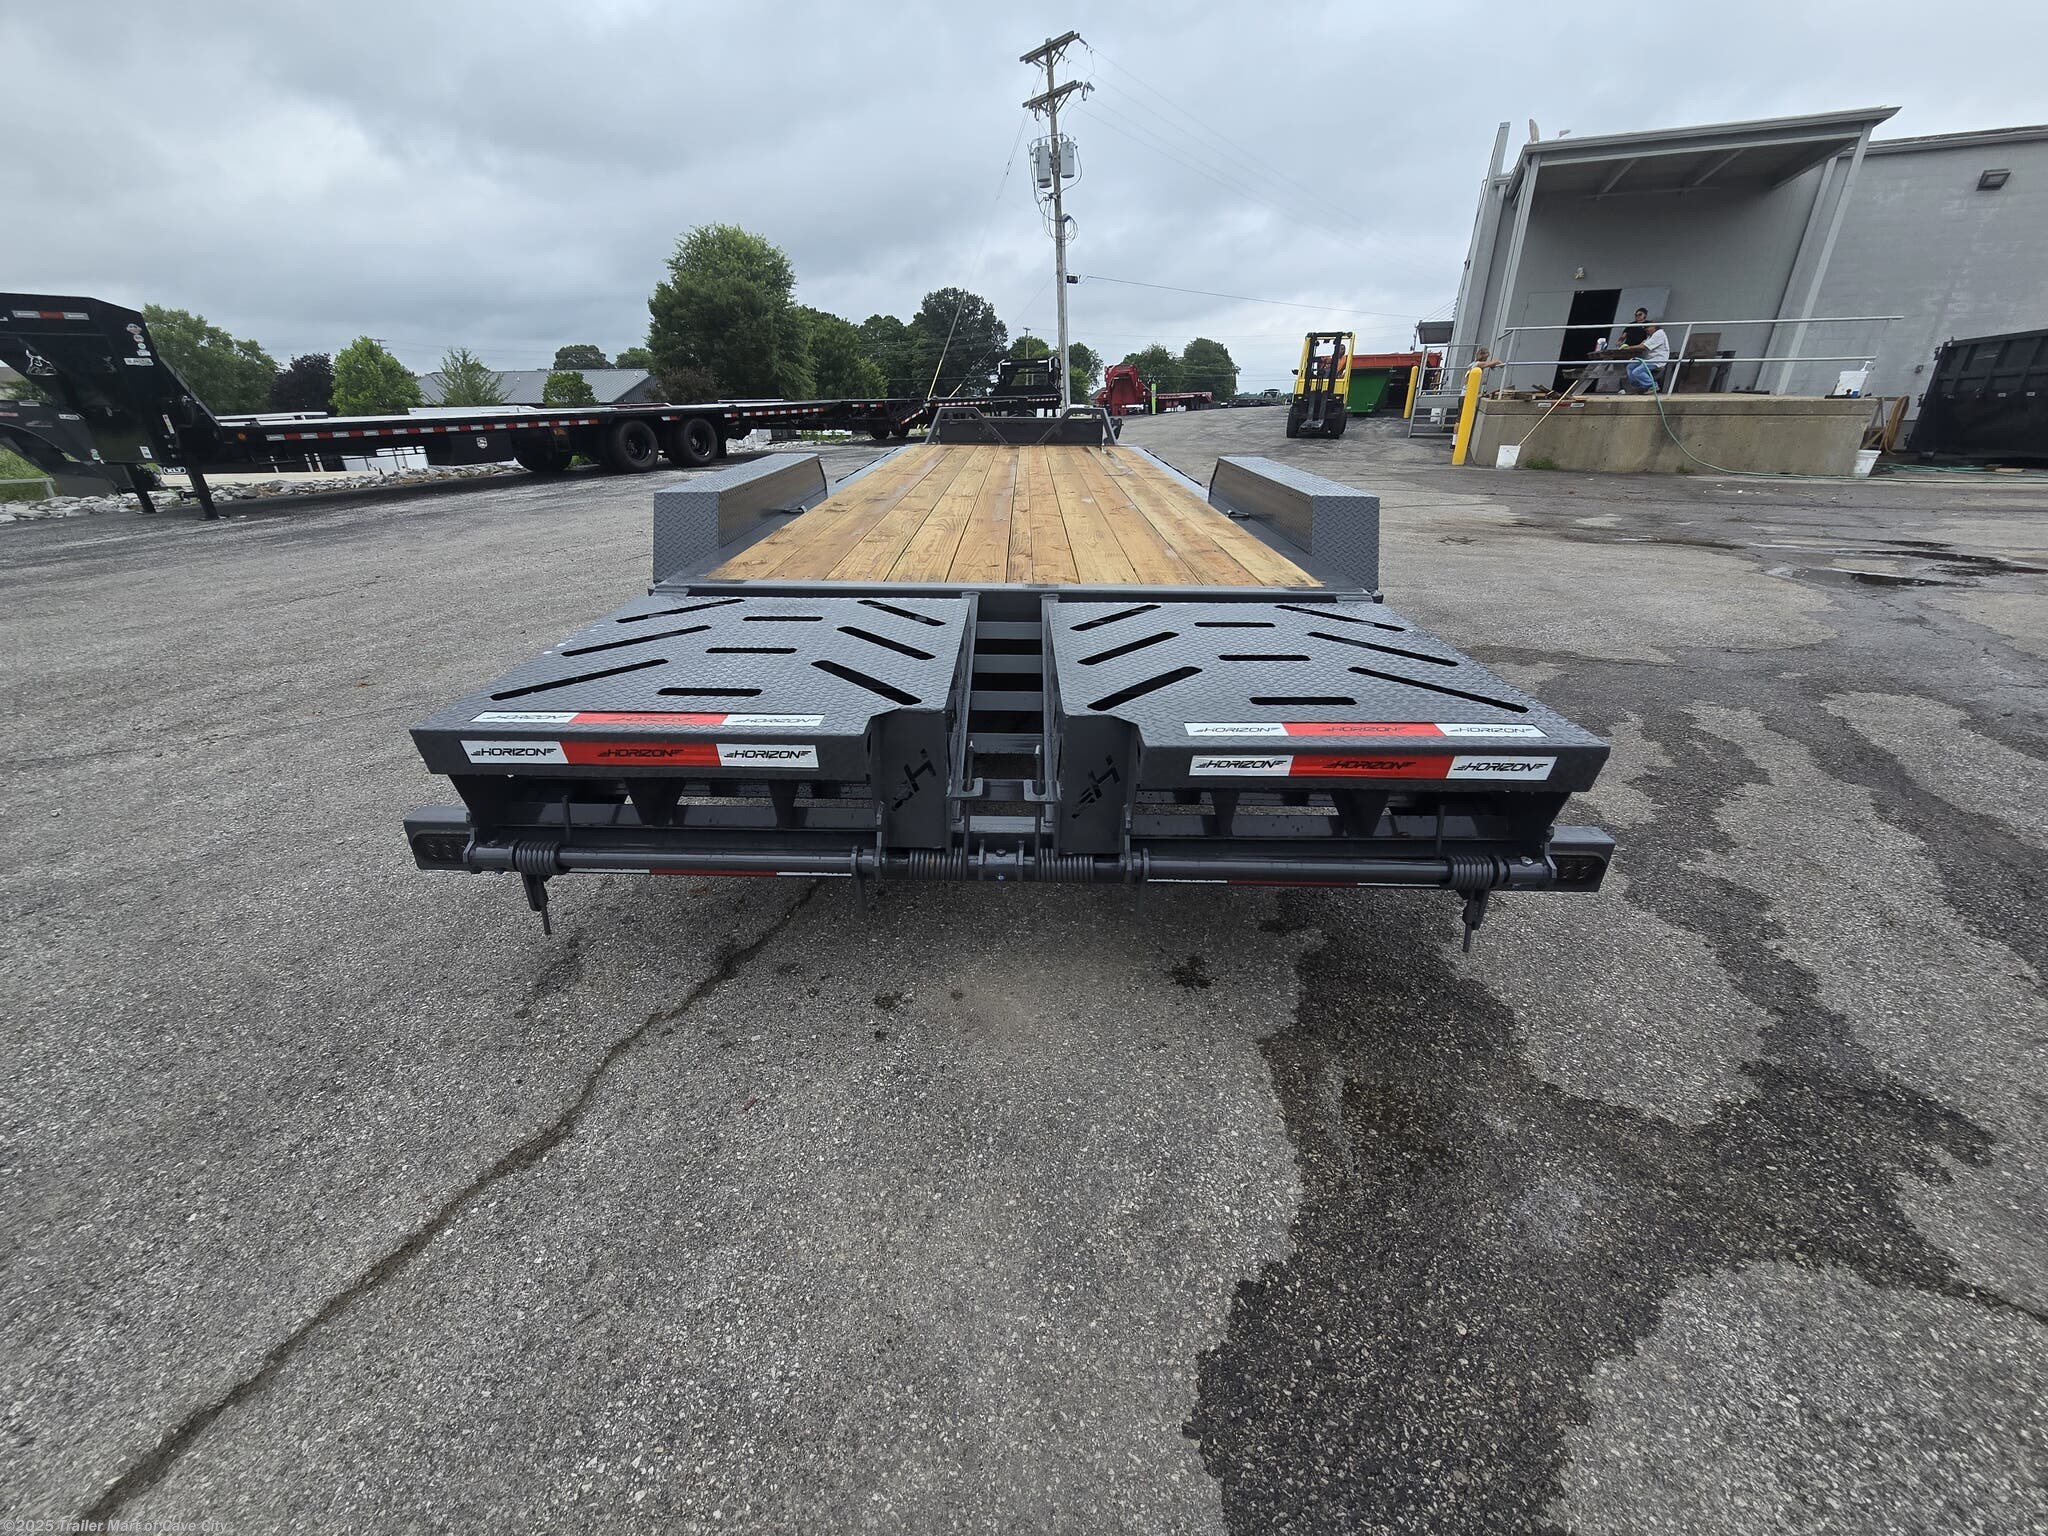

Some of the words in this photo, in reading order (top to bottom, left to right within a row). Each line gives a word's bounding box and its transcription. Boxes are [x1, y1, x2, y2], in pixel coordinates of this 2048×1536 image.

[481, 747, 547, 757] HORIZON
[607, 748, 674, 758] HORIZON
[734, 749, 801, 759] HORIZON
[1205, 760, 1277, 769] HORIZON
[1333, 760, 1408, 770] HORIZON
[1464, 762, 1537, 772] HORIZON
